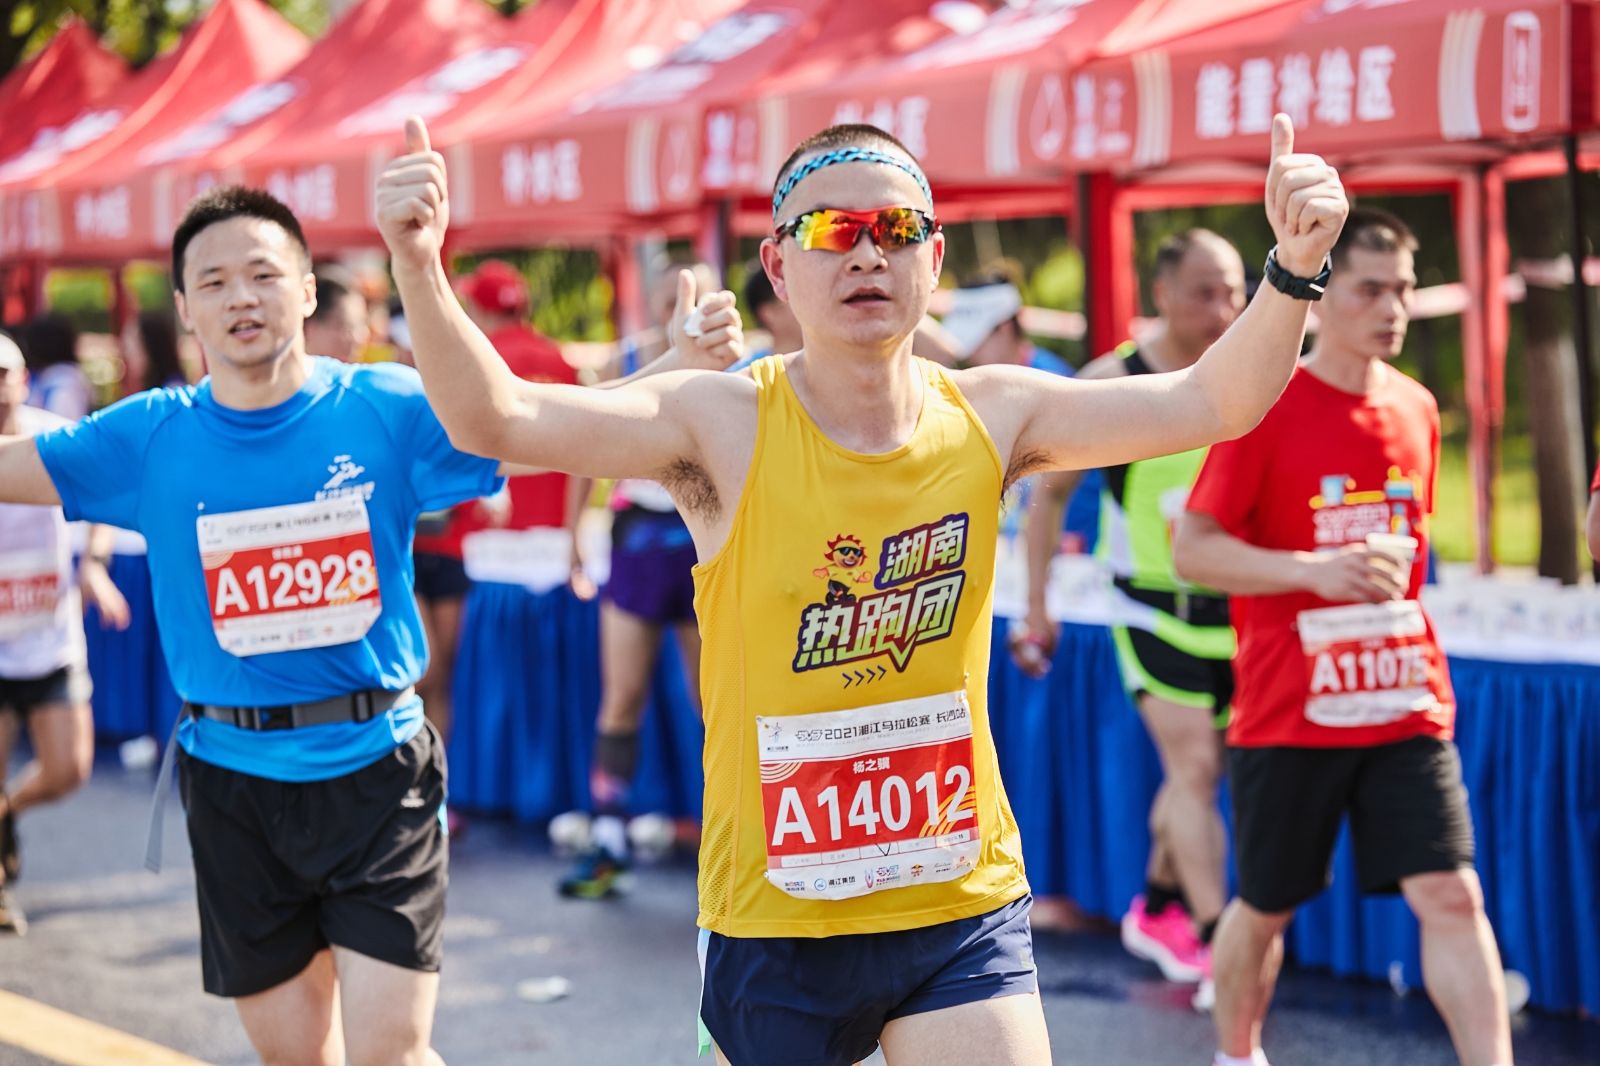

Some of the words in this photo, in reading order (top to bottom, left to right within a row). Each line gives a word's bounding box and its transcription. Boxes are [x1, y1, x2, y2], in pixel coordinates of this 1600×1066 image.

[214, 549, 376, 616] A12928
[879, 516, 968, 587] 湖南
[795, 572, 966, 669] 热跑团
[824, 714, 931, 740] 2021湘江马拉松赛
[936, 707, 966, 724] 长沙站
[771, 765, 974, 847] A14012
